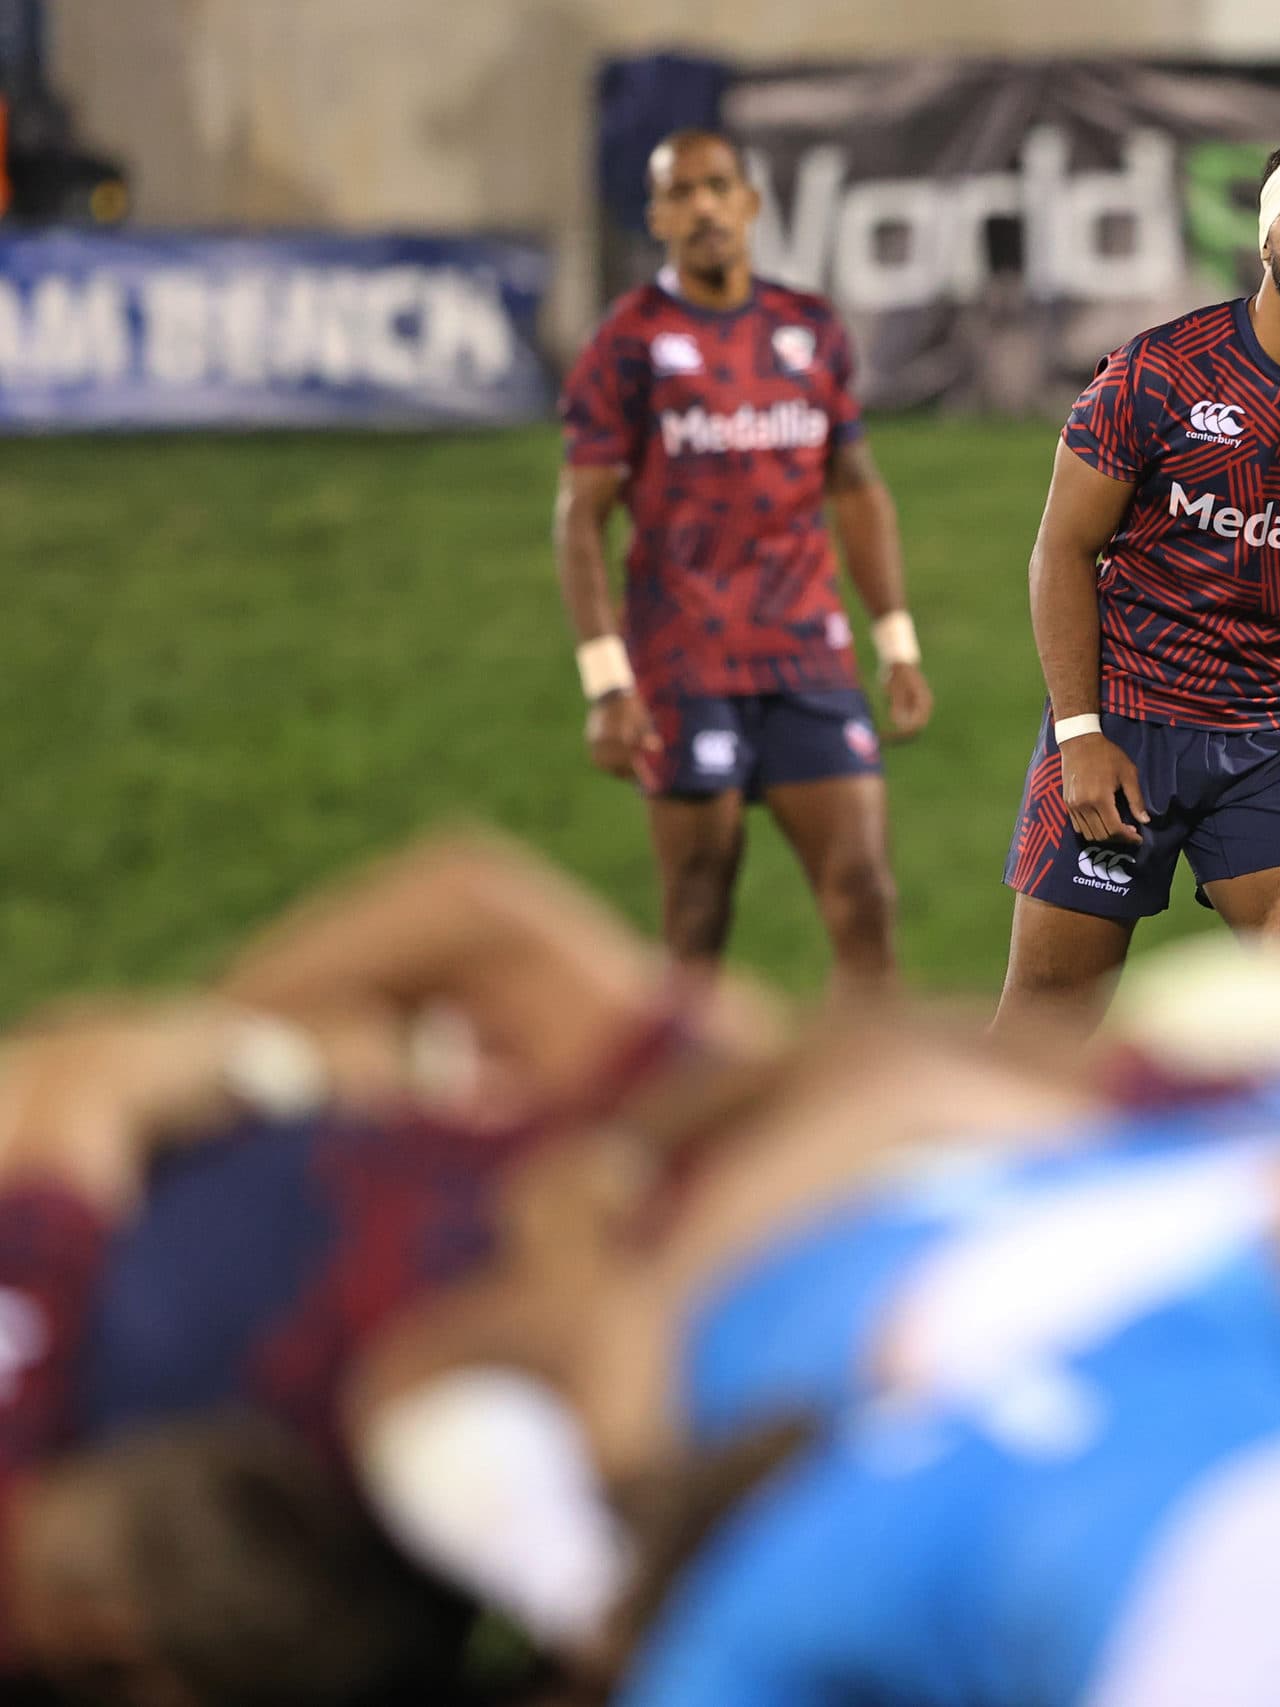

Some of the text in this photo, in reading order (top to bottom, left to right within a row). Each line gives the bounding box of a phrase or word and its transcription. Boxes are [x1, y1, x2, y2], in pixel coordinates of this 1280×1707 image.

[661, 399, 828, 457] Medallia
[1185, 431, 1242, 449] canterbury
[1073, 876, 1130, 896] canterbury
